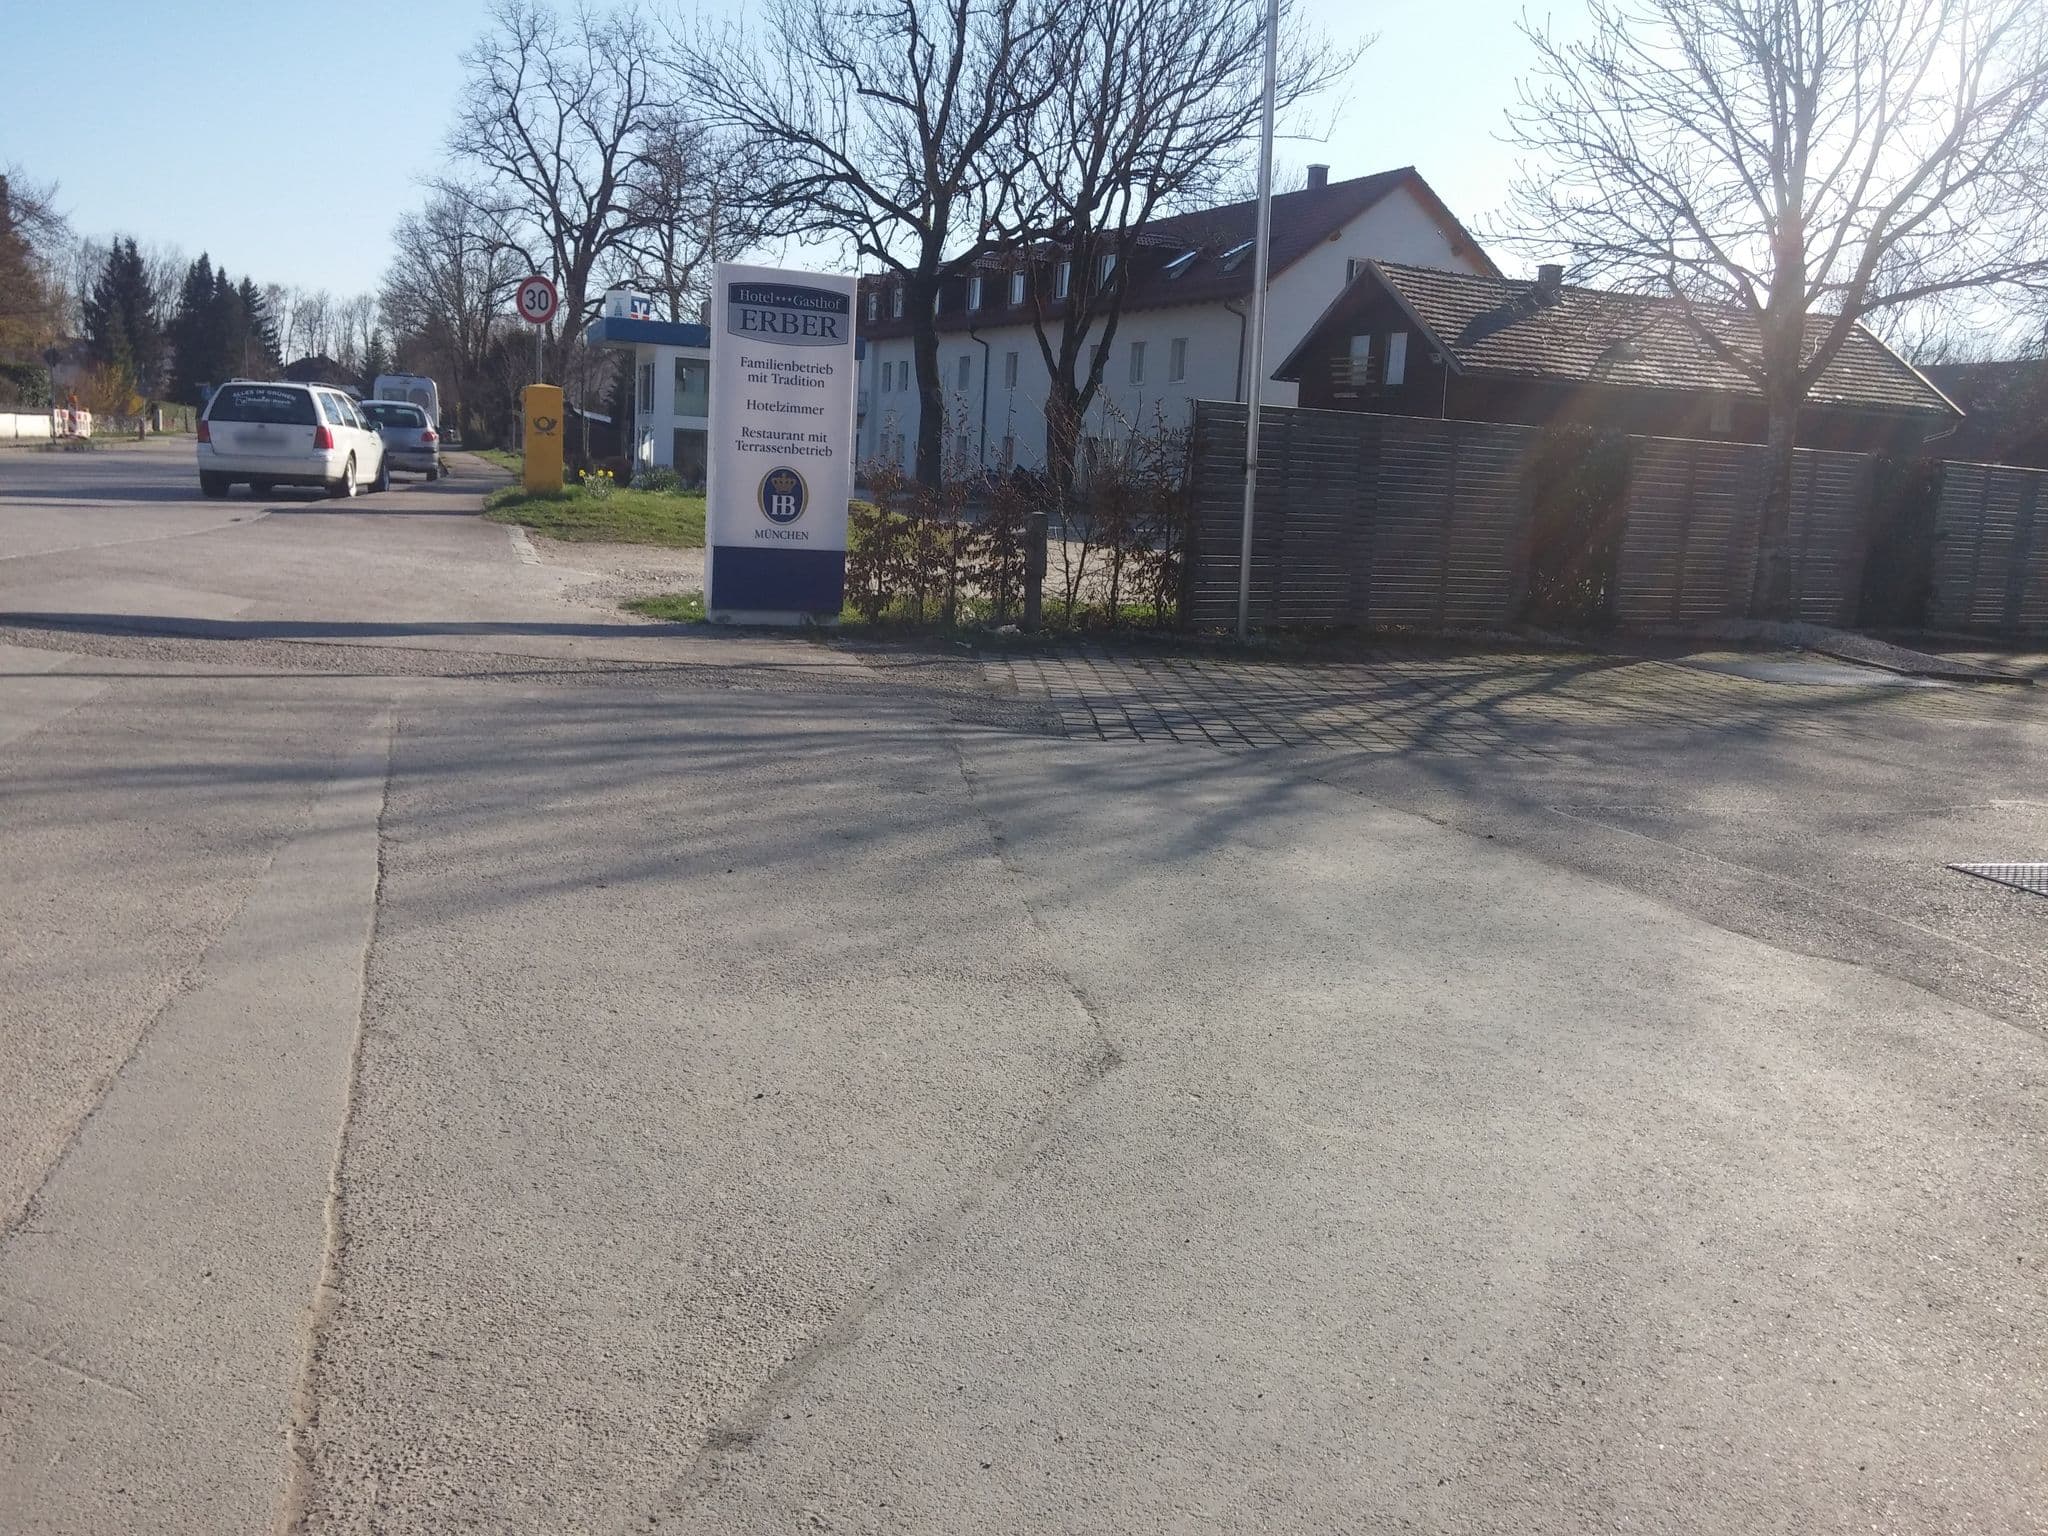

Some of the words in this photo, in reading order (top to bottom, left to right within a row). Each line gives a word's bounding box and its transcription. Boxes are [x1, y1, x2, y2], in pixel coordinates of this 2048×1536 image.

[525, 289, 549, 311] 30
[740, 289, 774, 303] Hotel
[793, 295, 841, 310] Gasthof
[739, 308, 839, 338] ERBER
[740, 356, 833, 375] Familienbetrieb
[748, 372, 768, 384] mit
[771, 373, 825, 388] Tradition
[746, 399, 824, 415] Hotelzimmer
[742, 426, 805, 442] Restaurant
[808, 432, 827, 443] mit
[735, 440, 833, 457] Terrassenbetrieb
[771, 494, 796, 515] HB
[754, 528, 809, 540] MÜNCHEN
